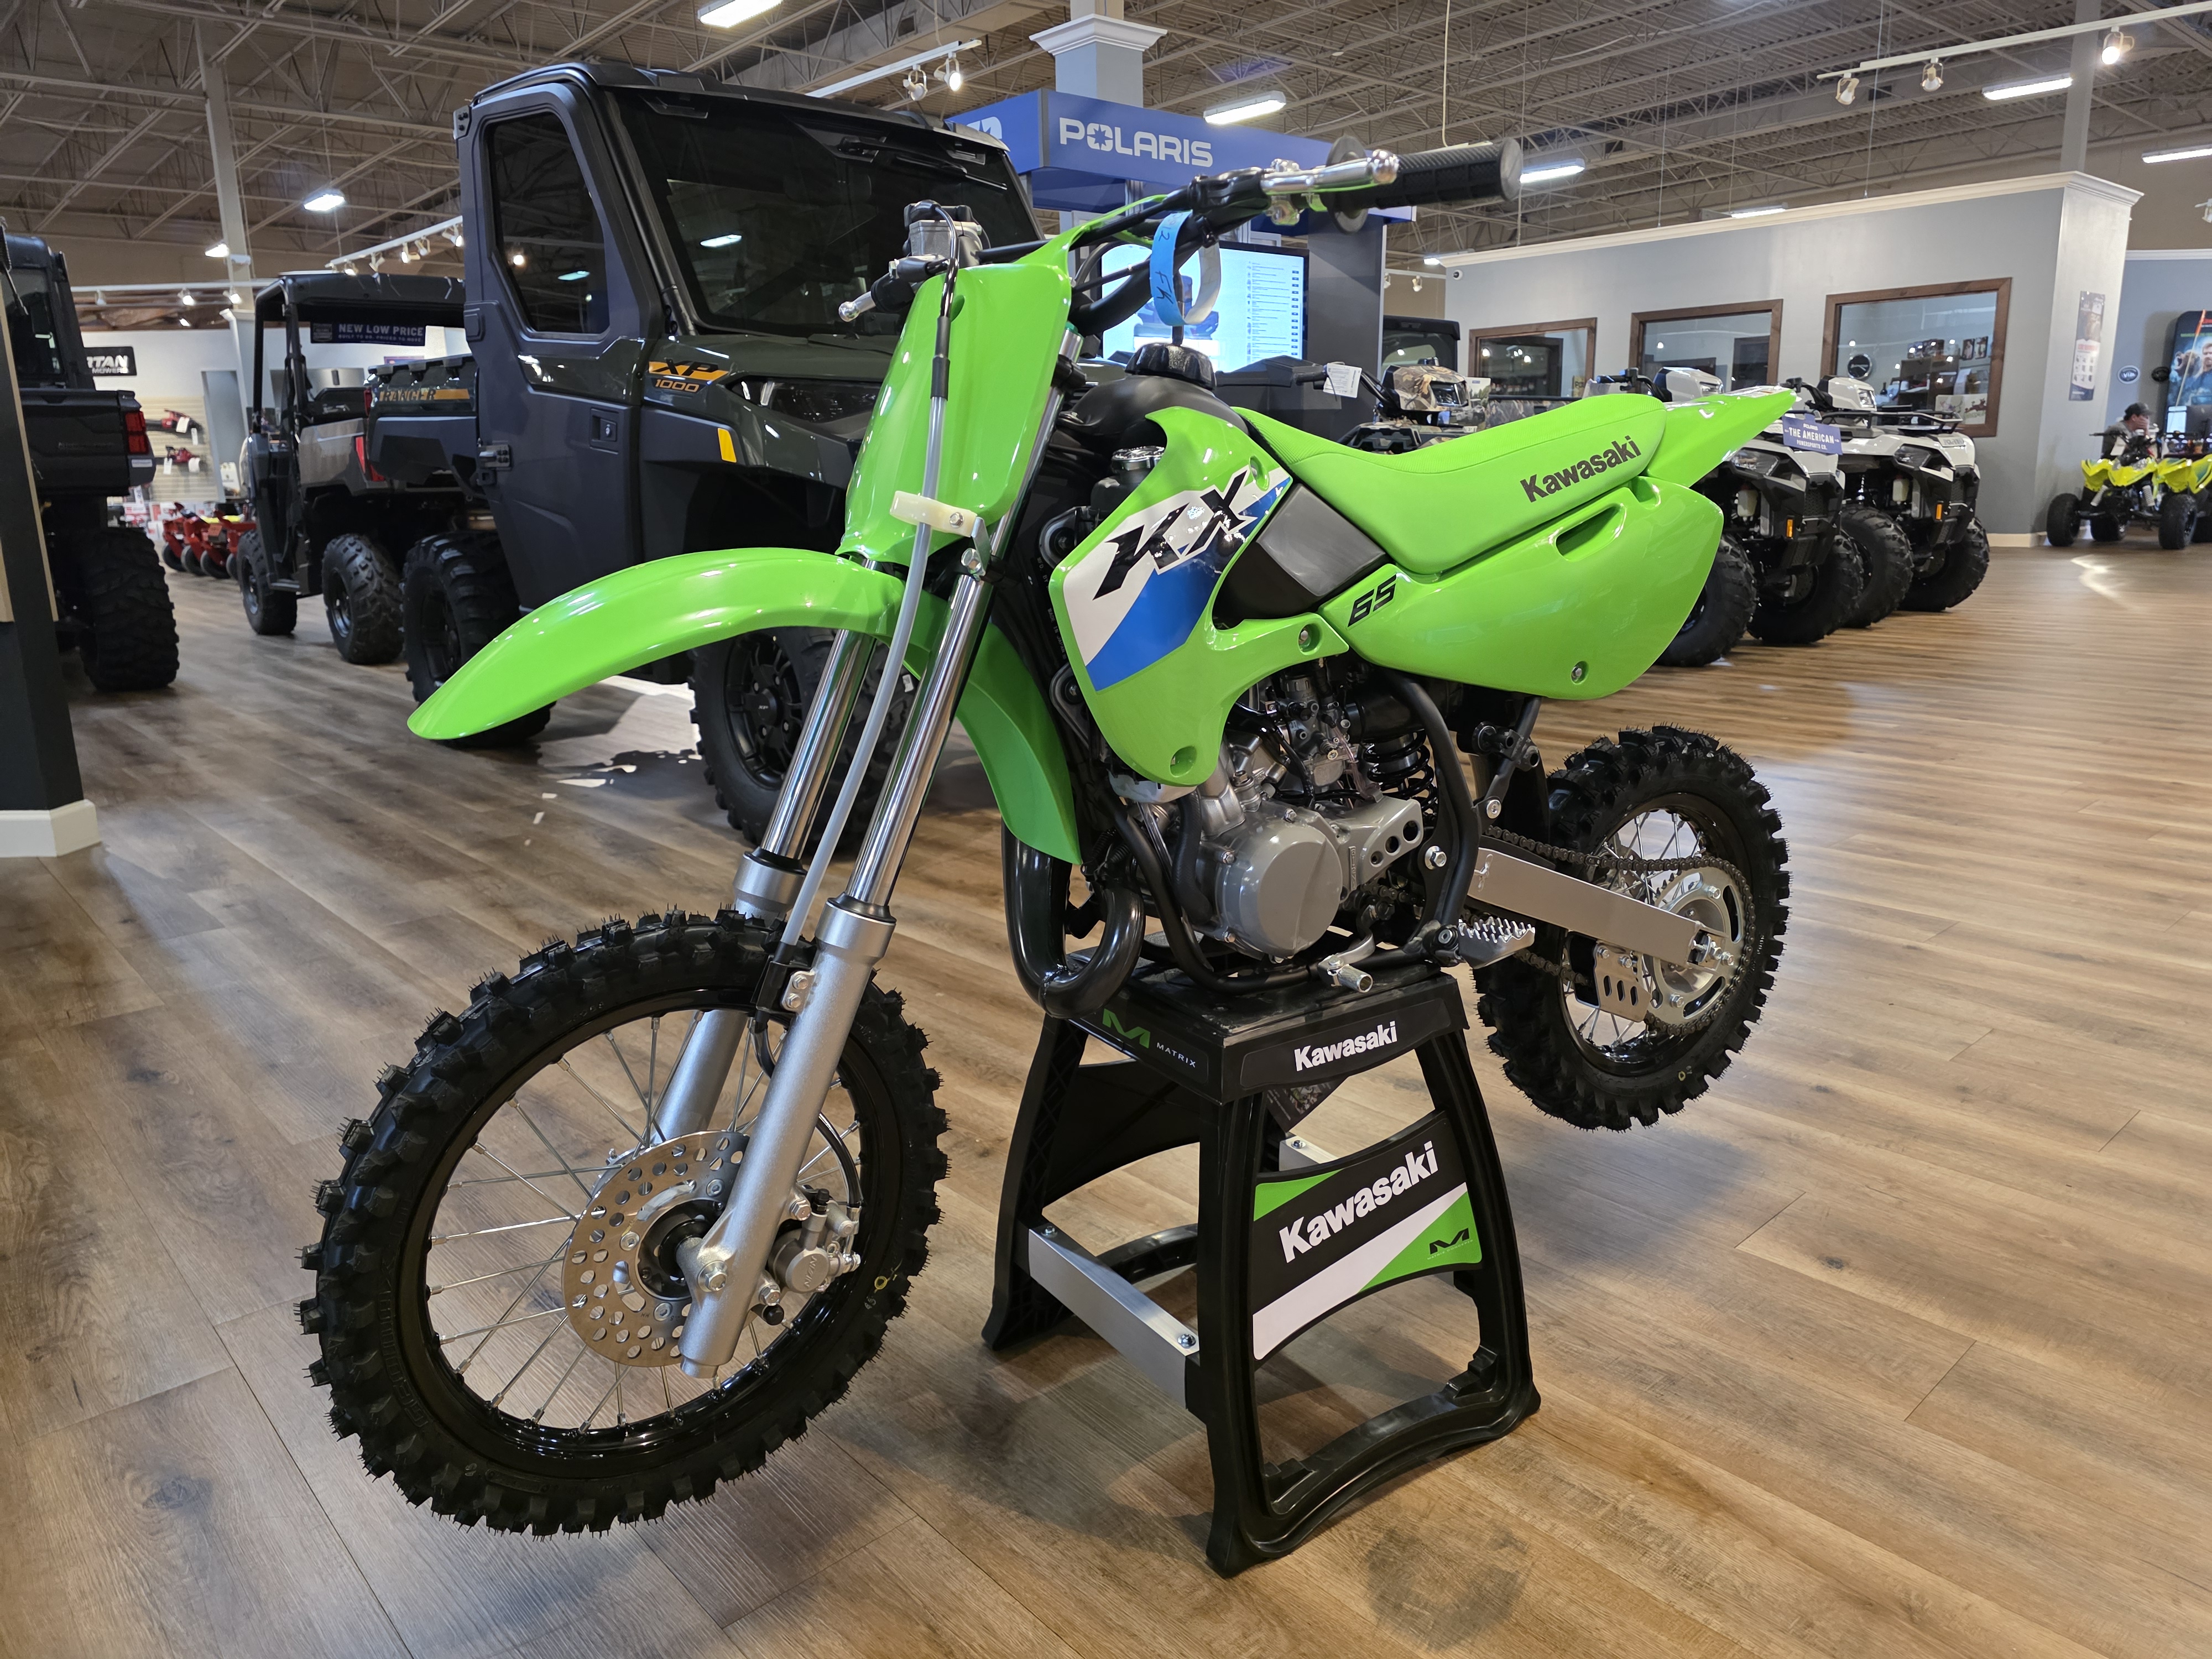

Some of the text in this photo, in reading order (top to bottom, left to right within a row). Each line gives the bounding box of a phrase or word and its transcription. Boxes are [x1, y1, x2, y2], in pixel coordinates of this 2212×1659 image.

[1060, 117, 1213, 168] POLARIS
[338, 324, 362, 333] NEW
[366, 325, 389, 334] LOW
[393, 327, 423, 336] PRICE
[653, 358, 718, 377] XP
[655, 379, 700, 393] 1000
[1789, 427, 1834, 444] THE AMERICAN
[1797, 440, 1820, 449] POWERSPORTS
[1520, 435, 1641, 503] Kawasaki
[1092, 470, 1248, 601] KX
[1348, 574, 1397, 628] 65
[1156, 1042, 1196, 1068] MATRIX
[1294, 1021, 1397, 1072] Kawasaki
[1279, 1140, 1438, 1263] Kawasaki
